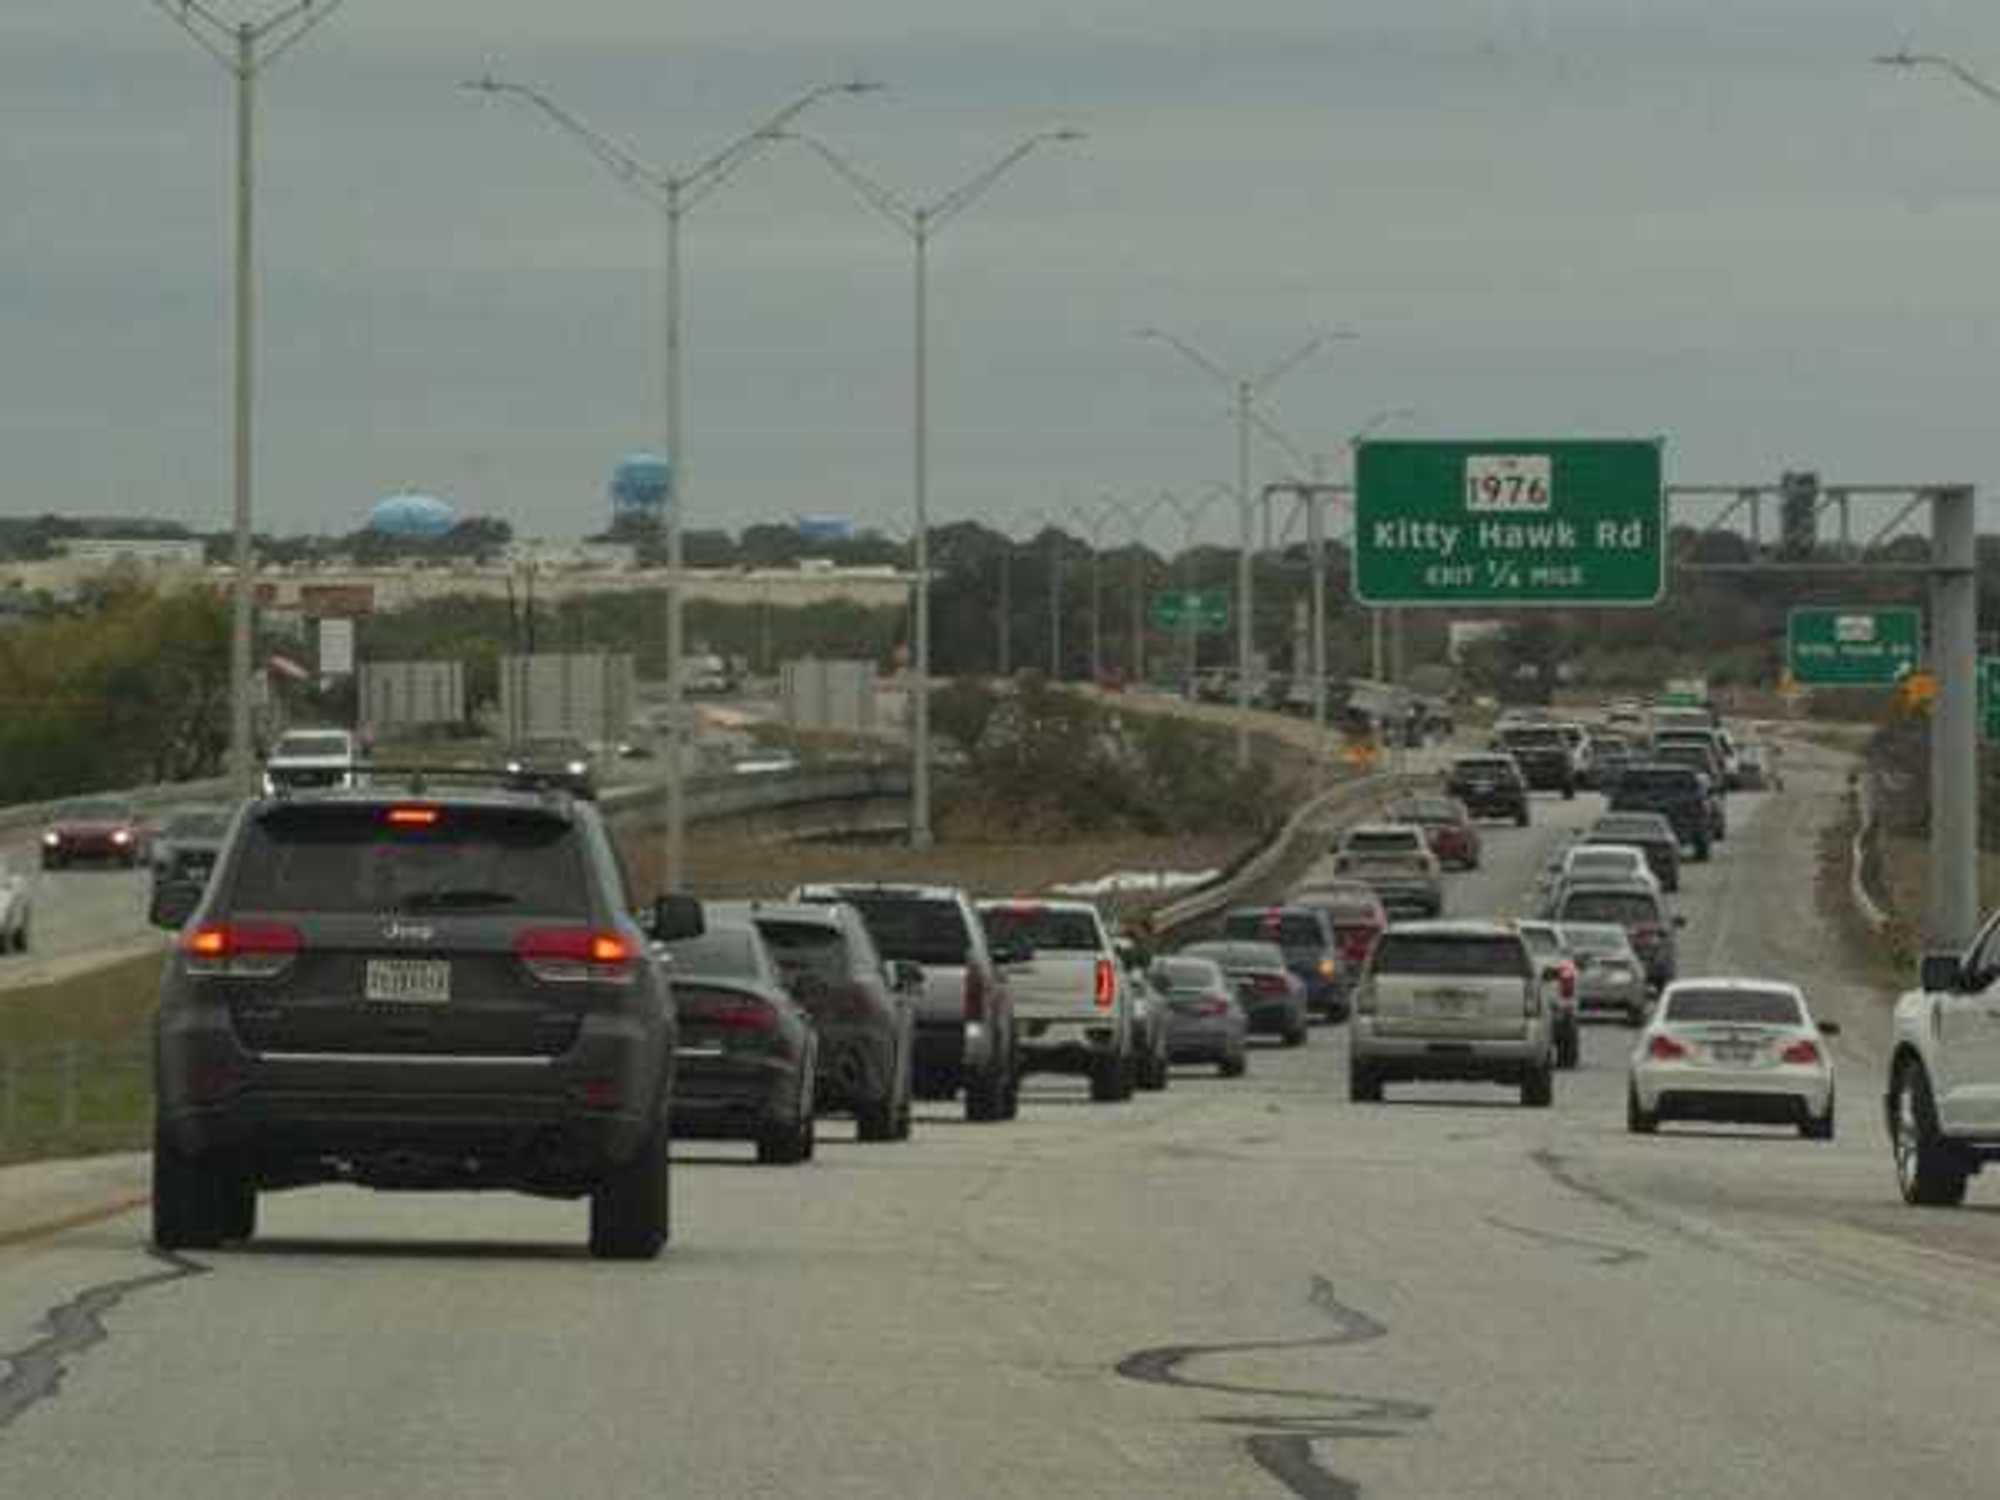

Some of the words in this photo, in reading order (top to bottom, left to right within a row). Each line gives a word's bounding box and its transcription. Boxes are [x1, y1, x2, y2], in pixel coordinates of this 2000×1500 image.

[1469, 474, 1547, 503] 1976
[1373, 520, 1460, 554] Kitty
[1479, 520, 1575, 548] Hawk
[1598, 519, 1642, 548] Rd
